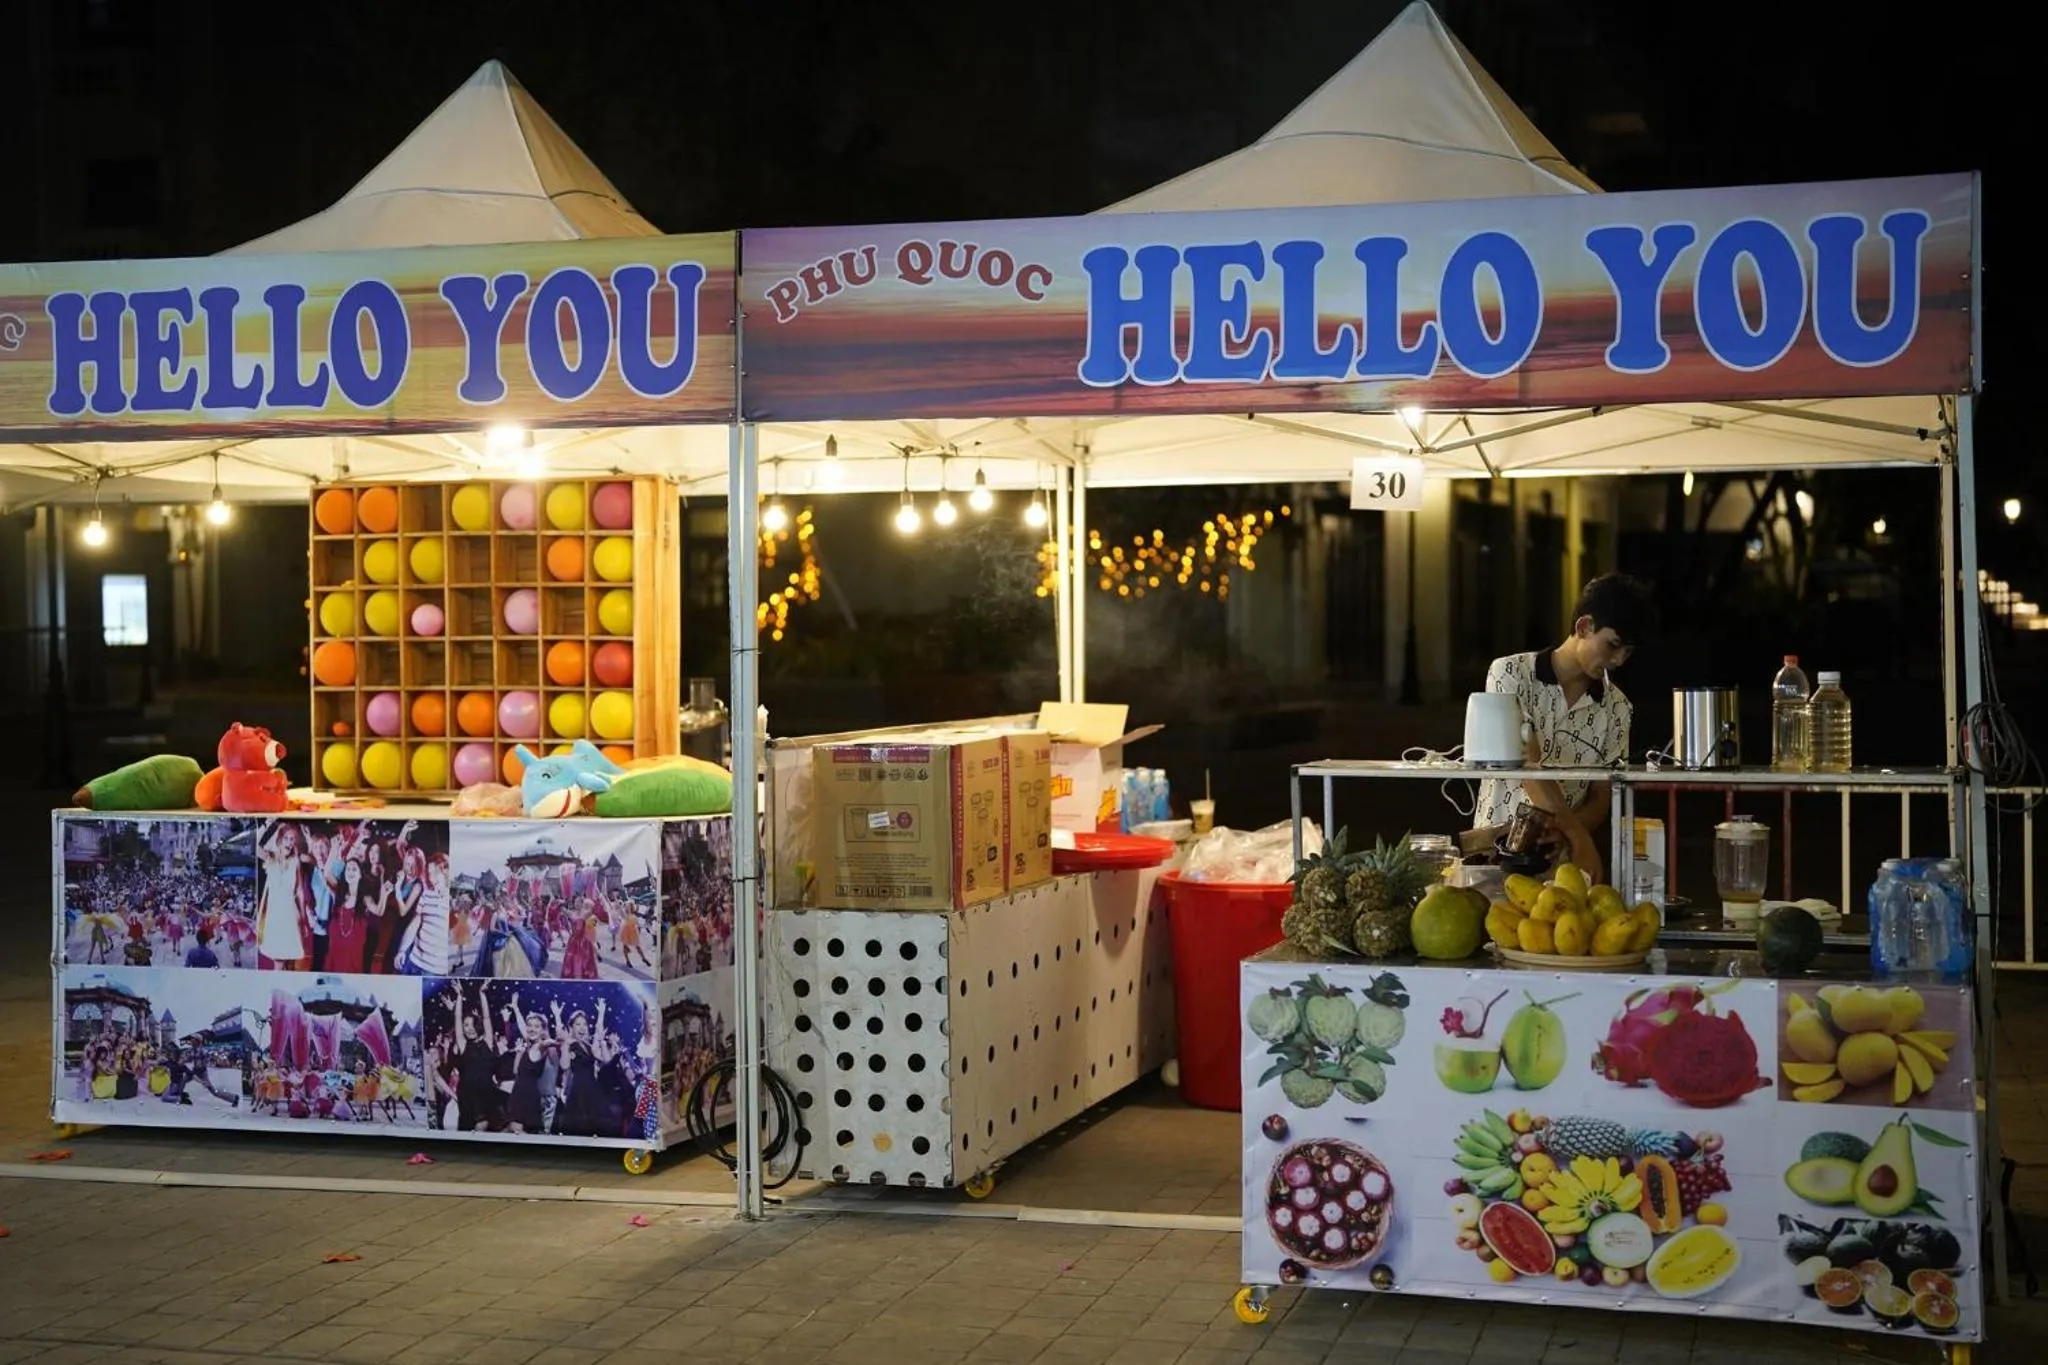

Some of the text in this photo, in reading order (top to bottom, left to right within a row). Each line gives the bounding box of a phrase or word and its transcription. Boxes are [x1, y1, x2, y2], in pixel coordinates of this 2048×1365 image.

[46, 262, 706, 418] HELLO YOU
[764, 238, 1053, 323] PHU QUOC
[1077, 208, 1931, 388] HELLO YOU
[1368, 471, 1406, 499] 30
